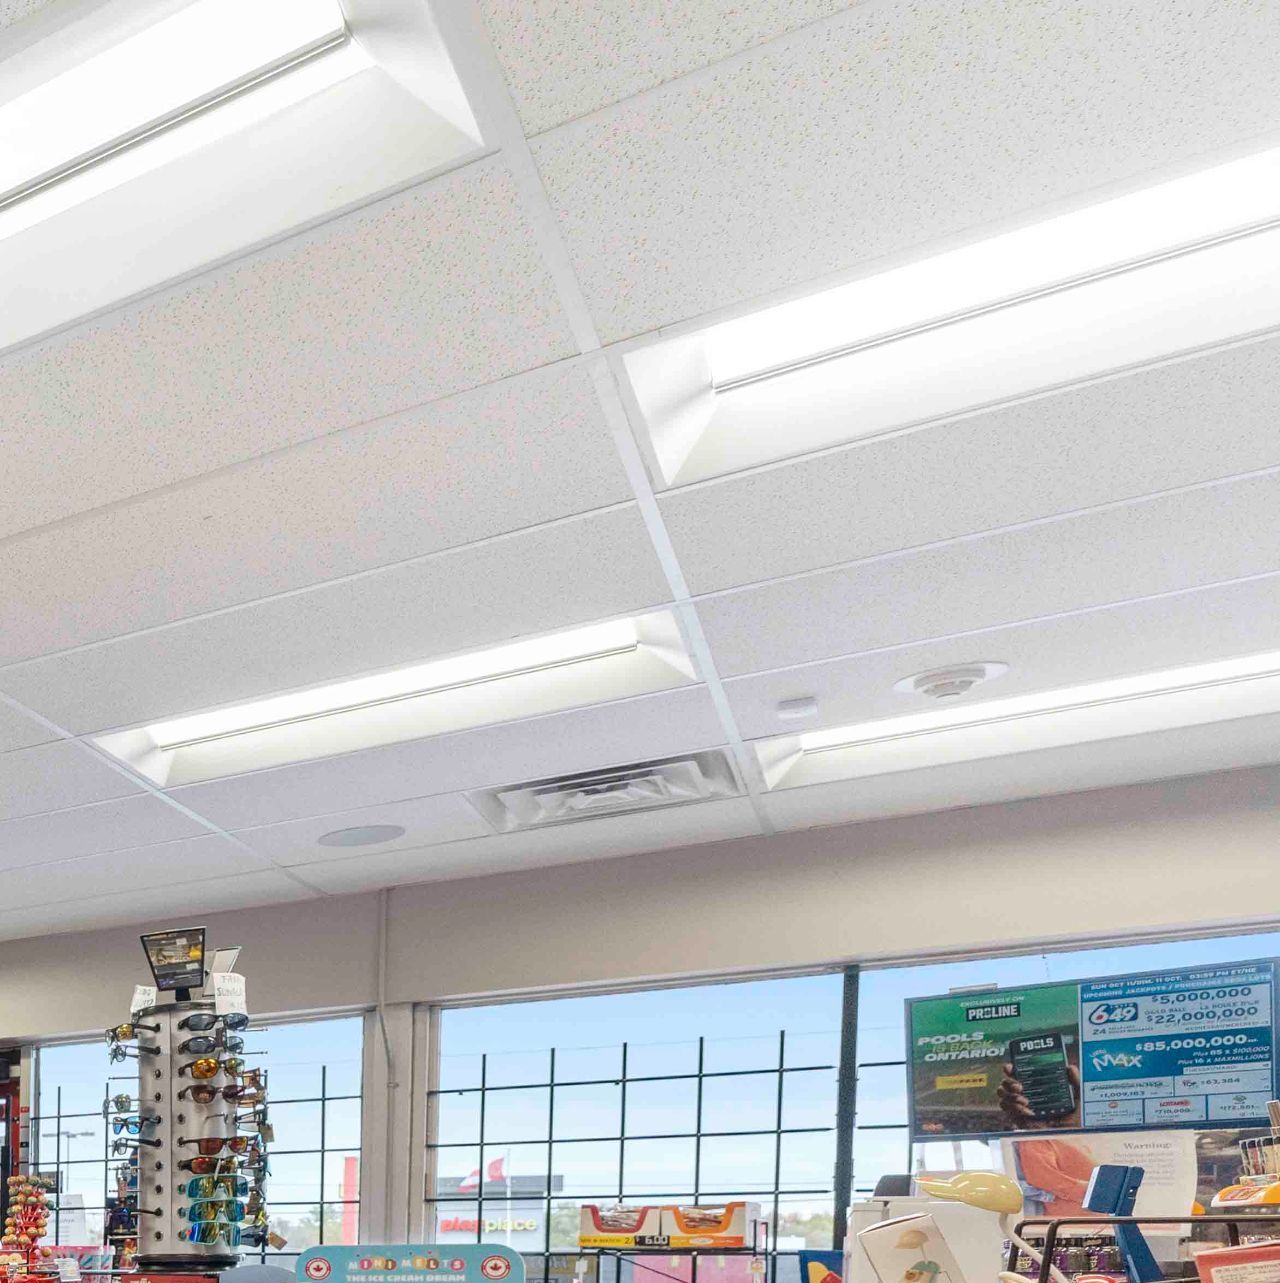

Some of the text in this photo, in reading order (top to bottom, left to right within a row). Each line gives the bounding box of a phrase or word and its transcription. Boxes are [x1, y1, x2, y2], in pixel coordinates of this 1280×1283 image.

[968, 1005, 1018, 1020] PROLINE
[917, 1032, 984, 1045] POOLS
[1020, 1038, 1054, 1051] POOLS
[924, 1048, 1006, 1062] ONTARIO!
[645, 1236, 668, 1245] 6.00
[348, 1256, 466, 1271] MINI MELTS
[387, 1274, 424, 1282] CREAM
[425, 1274, 466, 1282] DREAM
